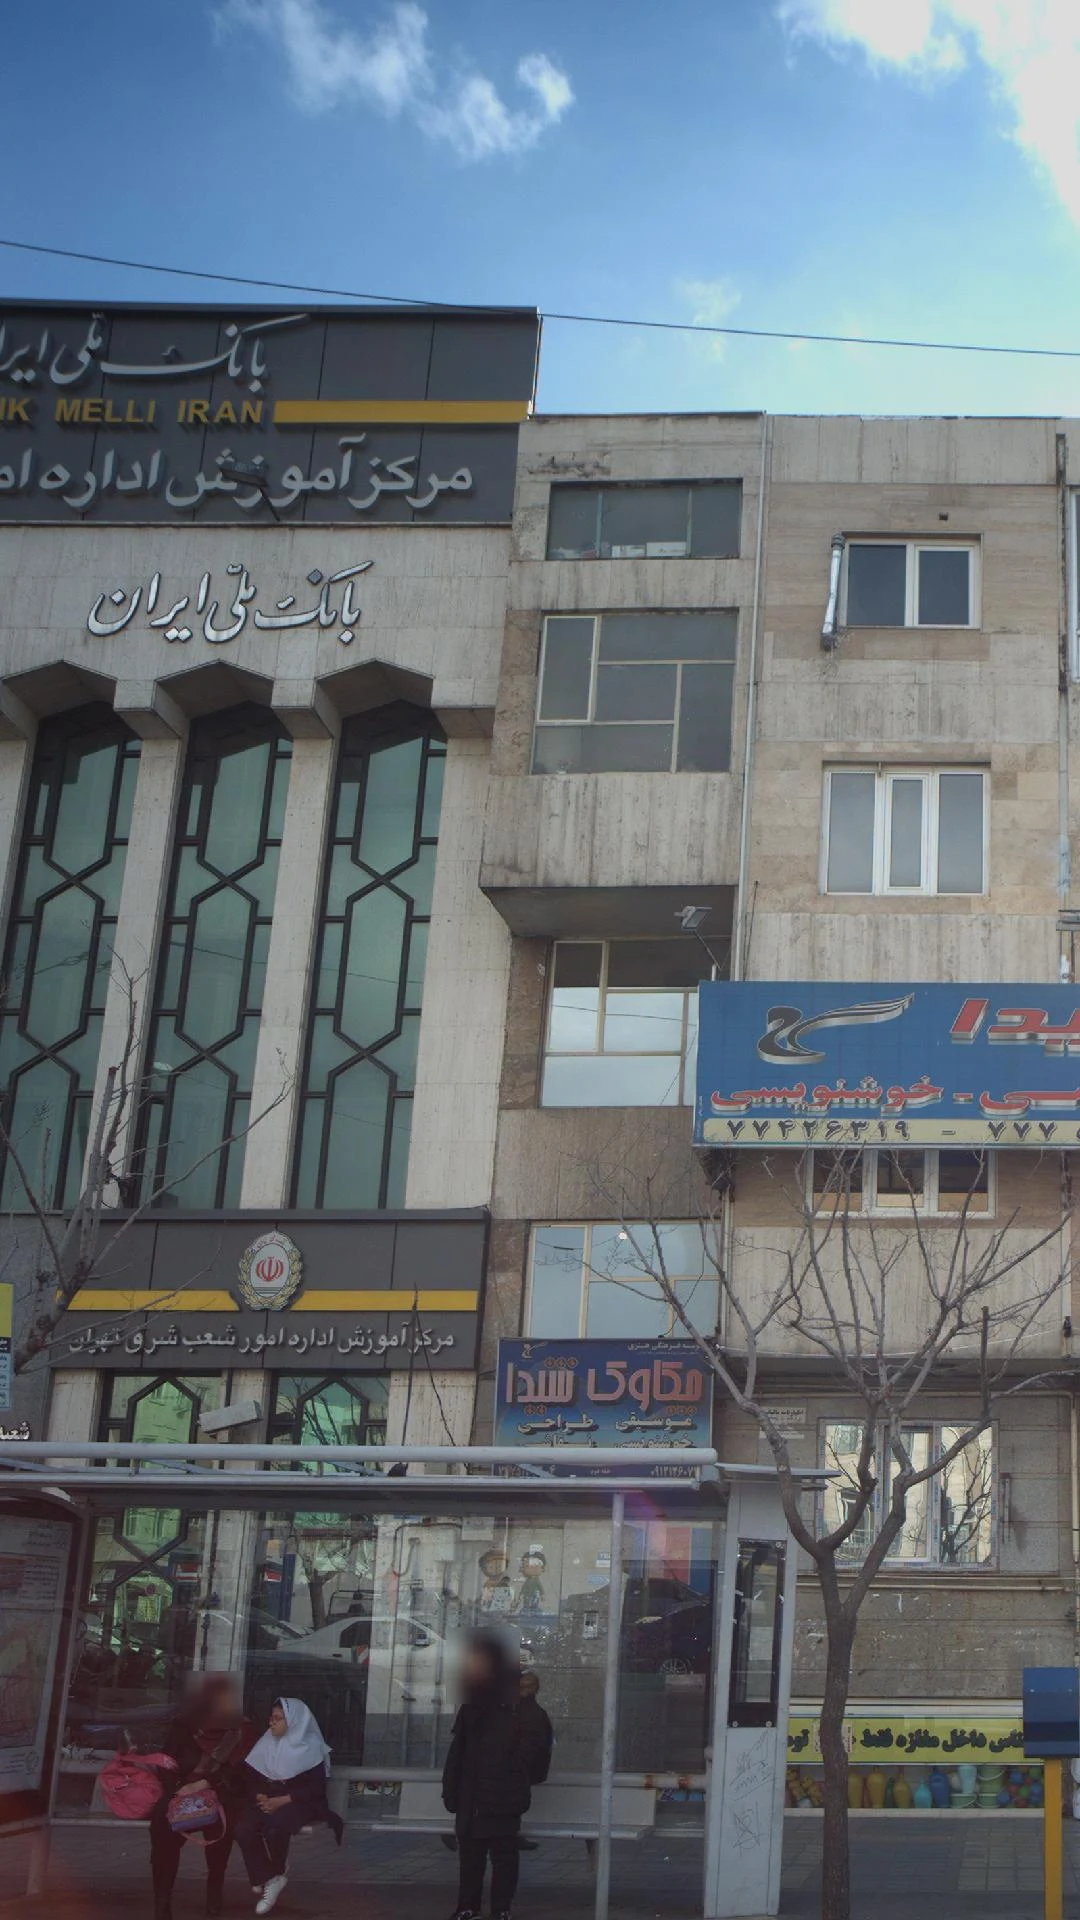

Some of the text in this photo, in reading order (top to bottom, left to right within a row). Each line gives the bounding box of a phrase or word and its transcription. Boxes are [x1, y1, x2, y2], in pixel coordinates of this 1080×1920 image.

[0, 319, 49, 382] ایرا
[101, 313, 310, 393] بانک
[55, 399, 156, 423] MELLI
[176, 399, 265, 424] IRAN
[0, 432, 473, 511] مرکز آموزش اداره ام
[87, 570, 211, 643] ایران
[253, 560, 376, 645] بانک
[950, 998, 1080, 1054] یدا
[711, 1075, 944, 1113] خوشنویسی
[988, 1121, 1080, 1141] ۷۷۷
[125, 1323, 177, 1354] شرق
[182, 1324, 236, 1352] شعب
[239, 1326, 285, 1353] امور
[288, 1326, 334, 1354] اداره
[337, 1321, 409, 1355] آموزش
[408, 1327, 454, 1354] مرکز
[506, 1358, 578, 1416] شیدا
[517, 1413, 594, 1433] طراحی
[616, 1411, 692, 1432] موسیقی
[860, 1727, 893, 1748] فقط
